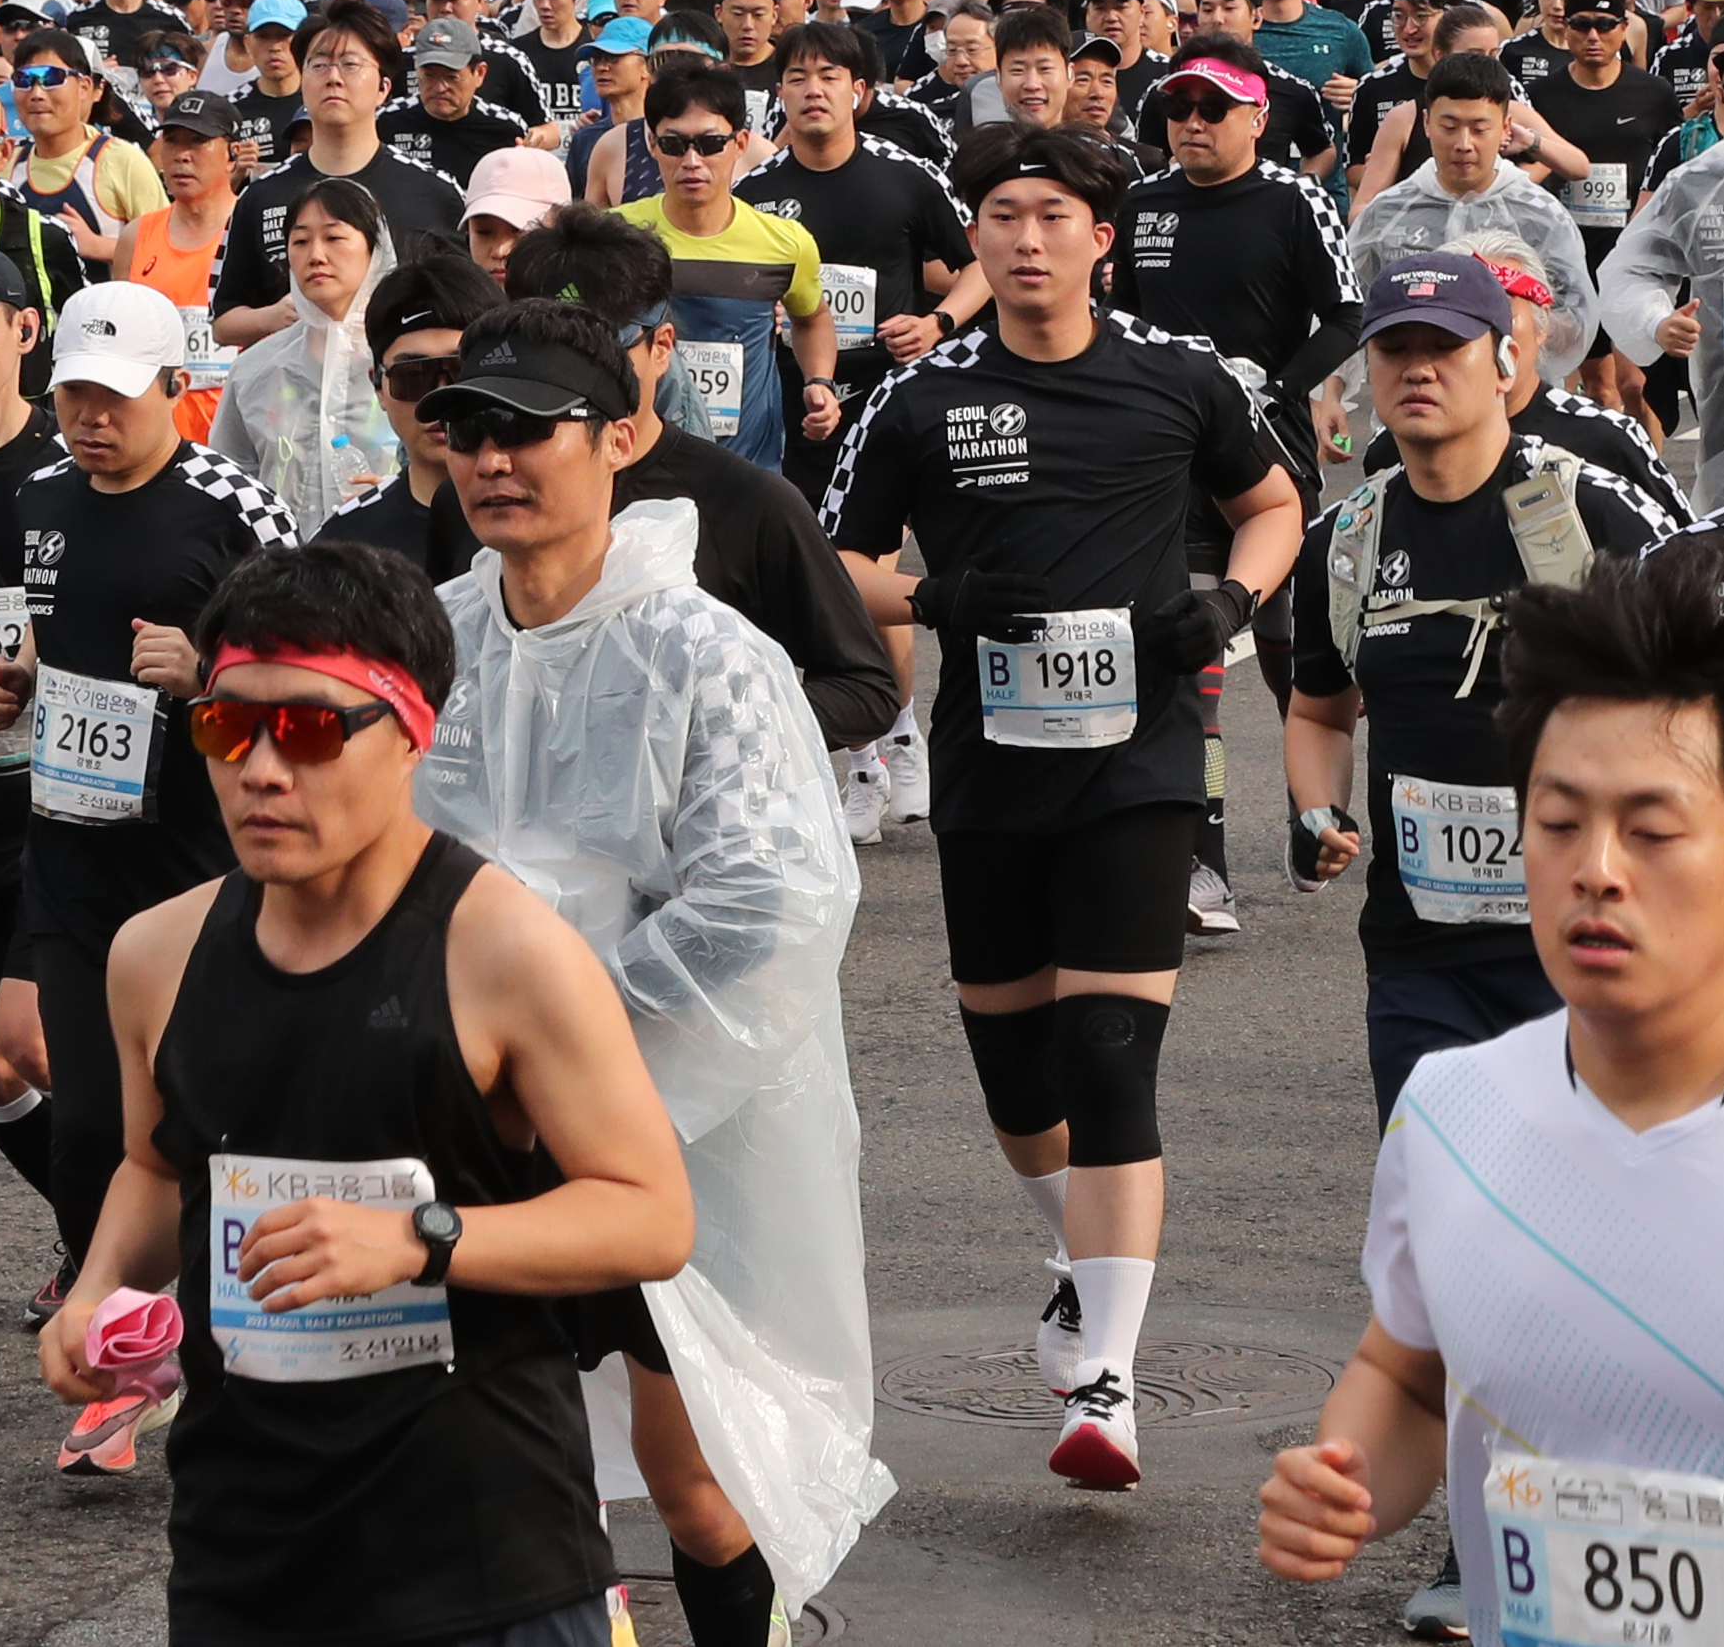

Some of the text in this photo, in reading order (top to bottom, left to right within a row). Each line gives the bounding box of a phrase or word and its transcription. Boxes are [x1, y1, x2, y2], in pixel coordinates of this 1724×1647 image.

[1583, 181, 1616, 199] 999
[1135, 224, 1152, 236] HALF
[1133, 234, 1174, 249] MARATHON
[1436, 271, 1459, 282] CITY
[946, 405, 988, 424] SEOUL
[947, 423, 984, 442] HALF
[948, 437, 1028, 461] MARATHON
[978, 471, 1030, 487] BROOKS
[989, 648, 1117, 689] B 1918
[986, 690, 1015, 701] HALF
[56, 713, 133, 762] 2163
[75, 793, 134, 815] 조선일보
[1402, 816, 1420, 854] B
[267, 1171, 417, 1202] KB금융그룹
[303, 1310, 334, 1326] HALF
[336, 1308, 404, 1326] MARATHON
[339, 1332, 440, 1363] 조선일보
[1502, 1524, 1704, 1621] B 850
[1500, 1599, 1543, 1622] HALF
